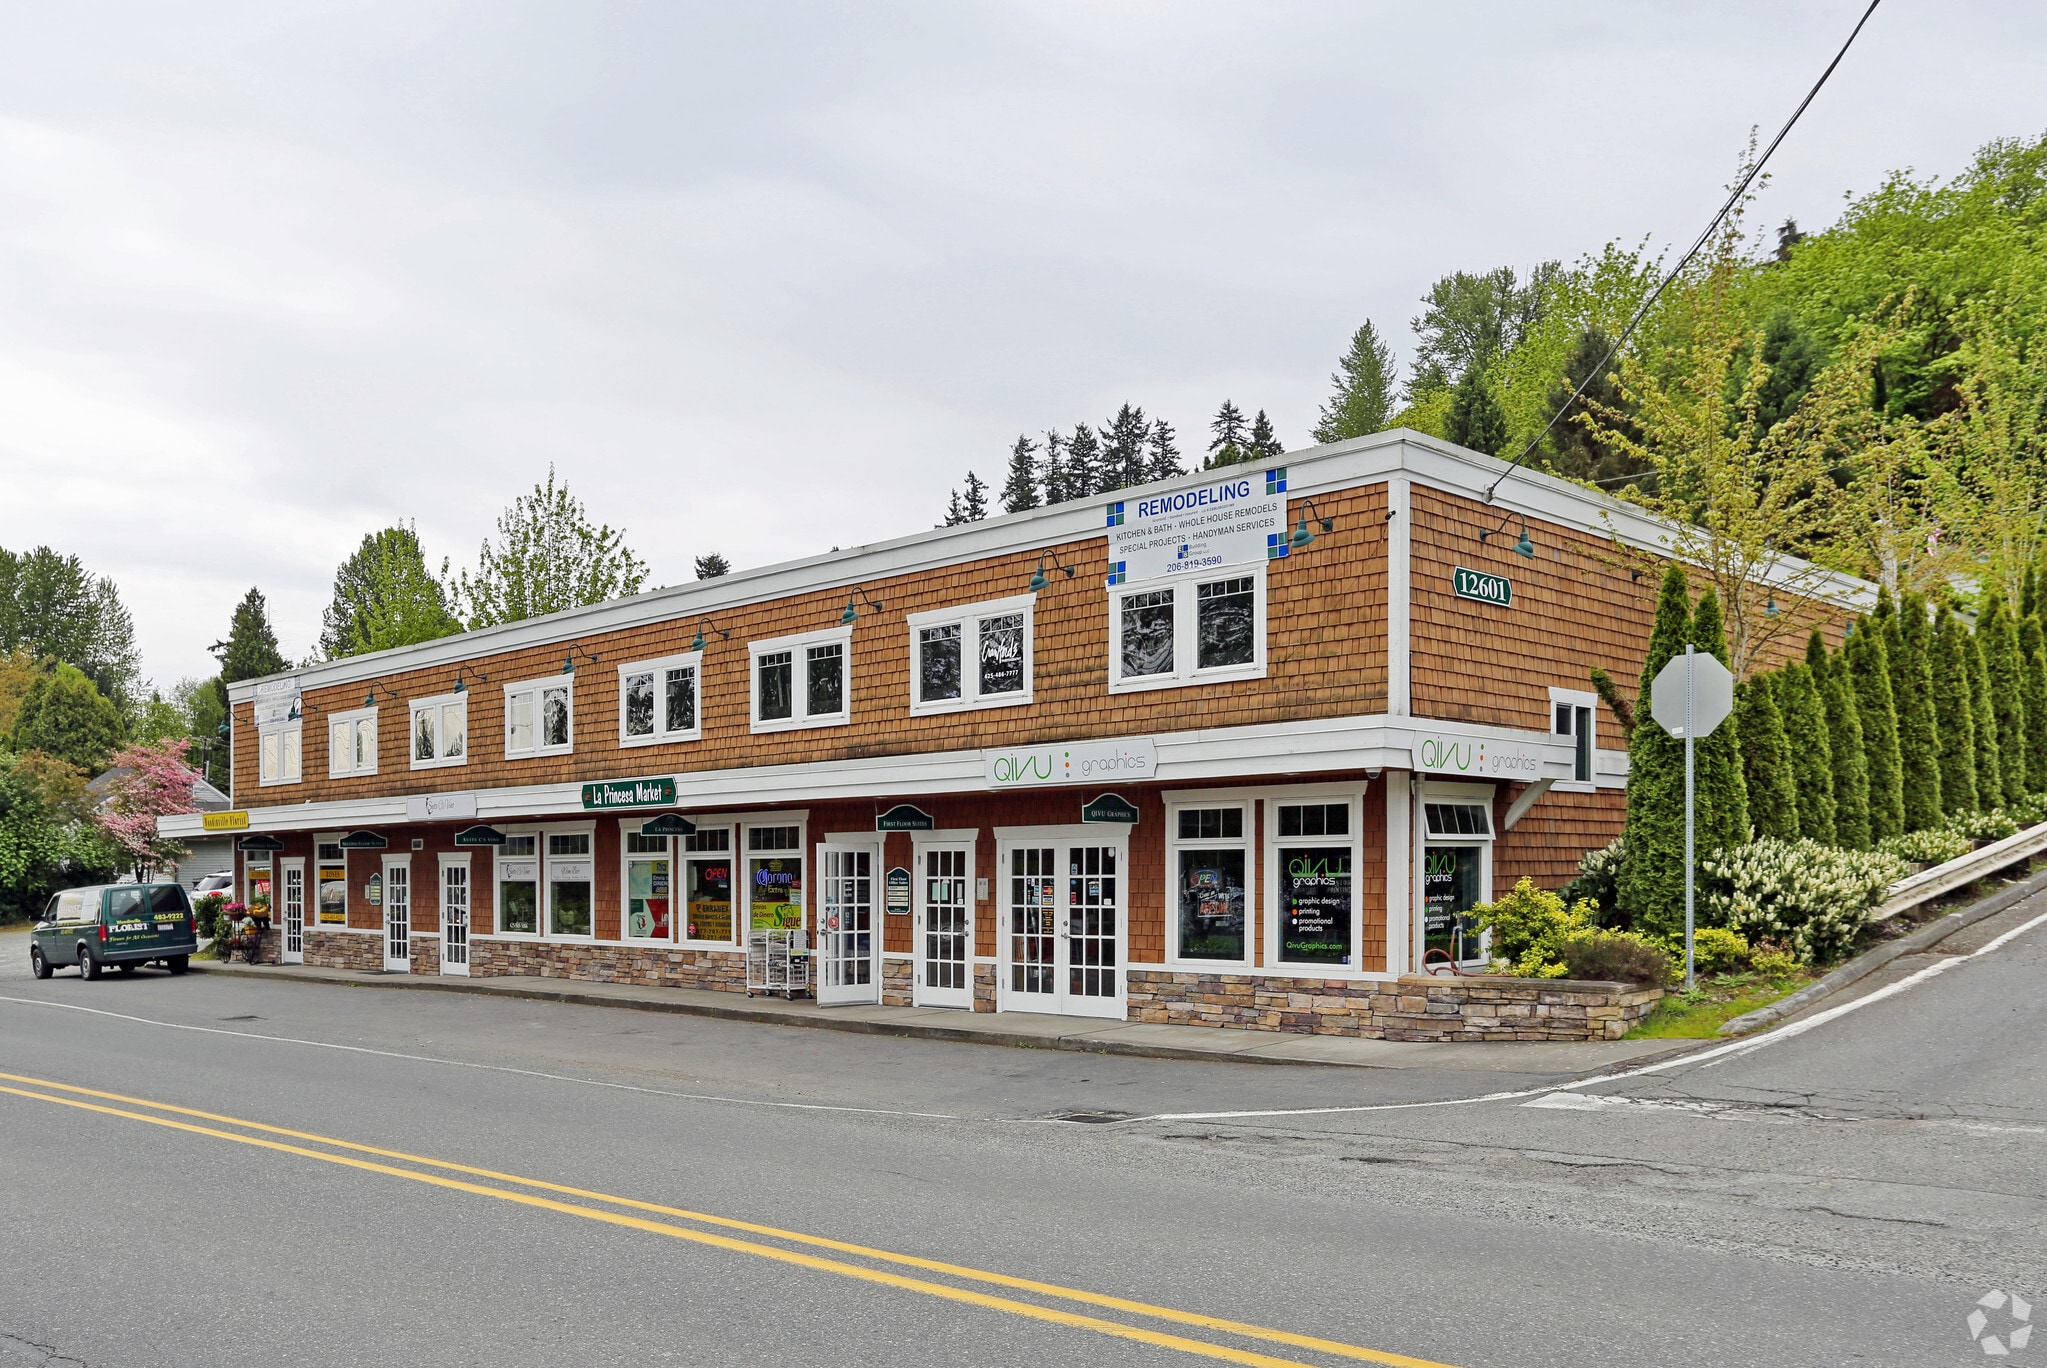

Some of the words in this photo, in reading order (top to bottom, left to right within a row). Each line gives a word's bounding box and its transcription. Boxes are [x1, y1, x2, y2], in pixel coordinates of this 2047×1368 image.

[1138, 480, 1250, 518] REMODELING
[1116, 528, 1146, 541] KITCHEN
[1147, 526, 1153, 535] &
[1153, 522, 1173, 534] BATH
[1178, 516, 1205, 529] WHOLE
[1206, 510, 1234, 523] HOUSE
[1234, 502, 1278, 518] REMODELS
[1119, 543, 1148, 554] SPECIAL
[1148, 534, 1186, 549] PROJECTS
[1192, 525, 1235, 540] HANDYMAN
[1236, 517, 1275, 532] SERVICES
[1166, 555, 1222, 573] 206-819-3590
[1459, 572, 1507, 602] 12601
[1081, 748, 1146, 777] graphics
[1492, 748, 1537, 773] graphics
[593, 786, 602, 805] La
[604, 784, 634, 804] Princesa
[635, 782, 662, 802] Market
[705, 867, 727, 880] OPEN
[756, 869, 793, 887] Corona
[1293, 872, 1336, 889] graphics
[1425, 869, 1452, 886] graphics
[1298, 897, 1320, 906] graphic
[1321, 896, 1341, 906] design
[1428, 894, 1442, 903] graphic
[1443, 894, 1455, 902] design
[773, 905, 801, 928] Sigue
[1298, 908, 1320, 916] printing
[1428, 906, 1443, 914] printing
[1428, 914, 1451, 923] promotional
[109, 923, 148, 933] FLORIST
[1298, 917, 1333, 926] promotional
[1298, 924, 1323, 933] products
[1428, 922, 1444, 931] products
[1286, 941, 1343, 950] QivuGraphics.com
